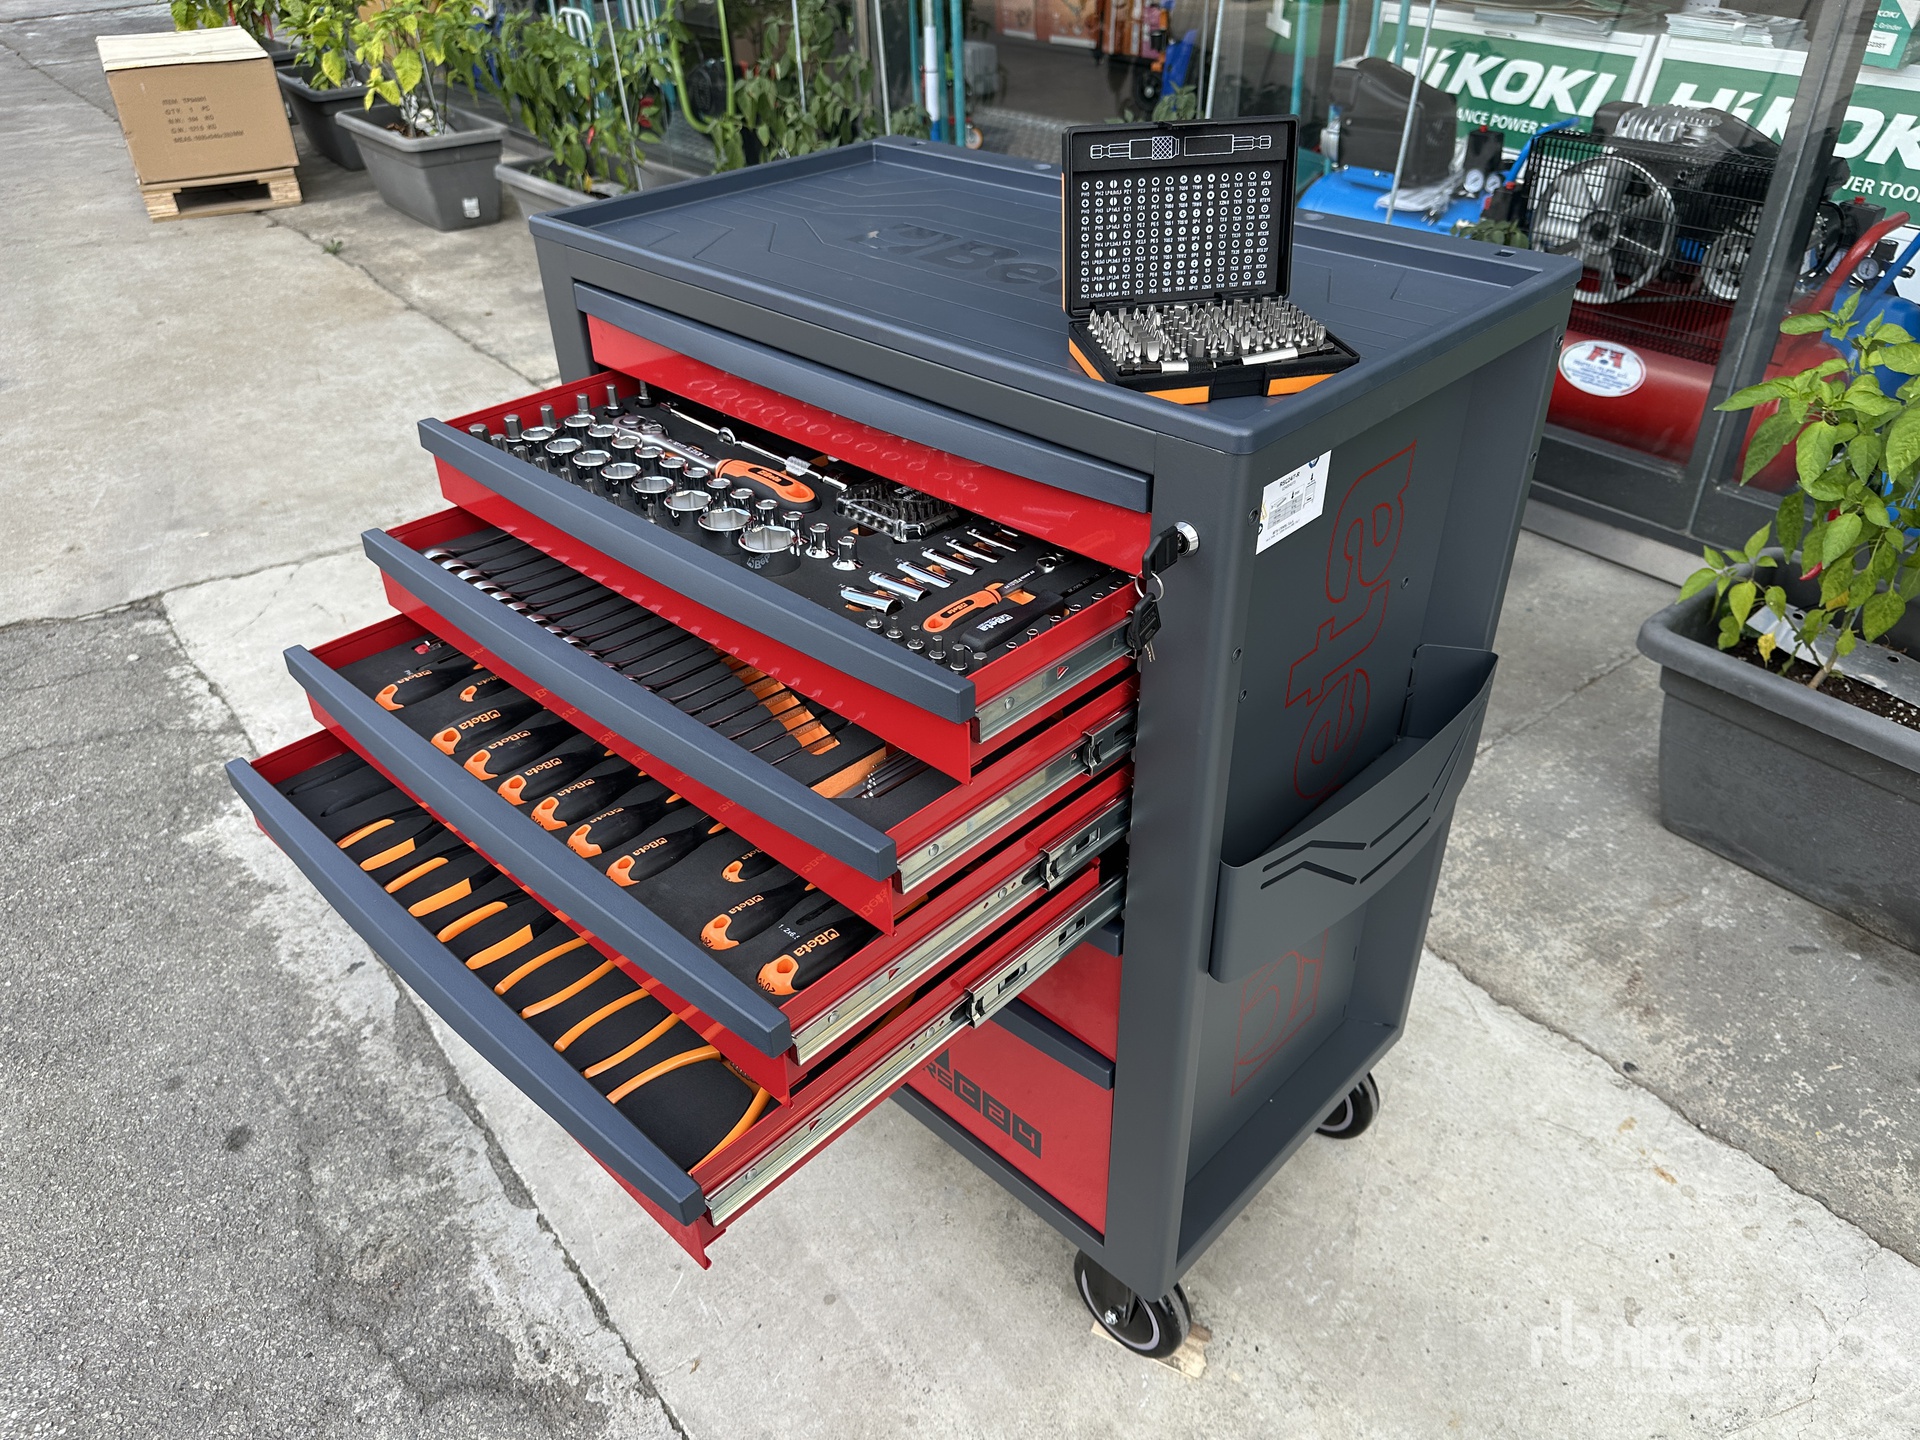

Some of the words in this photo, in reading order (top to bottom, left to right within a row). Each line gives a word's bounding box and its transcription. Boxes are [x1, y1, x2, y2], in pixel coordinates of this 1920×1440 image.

[1387, 42, 1617, 118] HiKOKI
[1490, 114, 1539, 135] POWER
[1879, 181, 1920, 204] TOO
[458, 713, 492, 730] Beta
[488, 732, 520, 749] Beta
[525, 760, 555, 776] Beta
[557, 780, 585, 797] Beta
[590, 809, 616, 824] Beta
[632, 841, 659, 856] Beta
[728, 898, 754, 915] Beta
[793, 933, 830, 957] Beta
